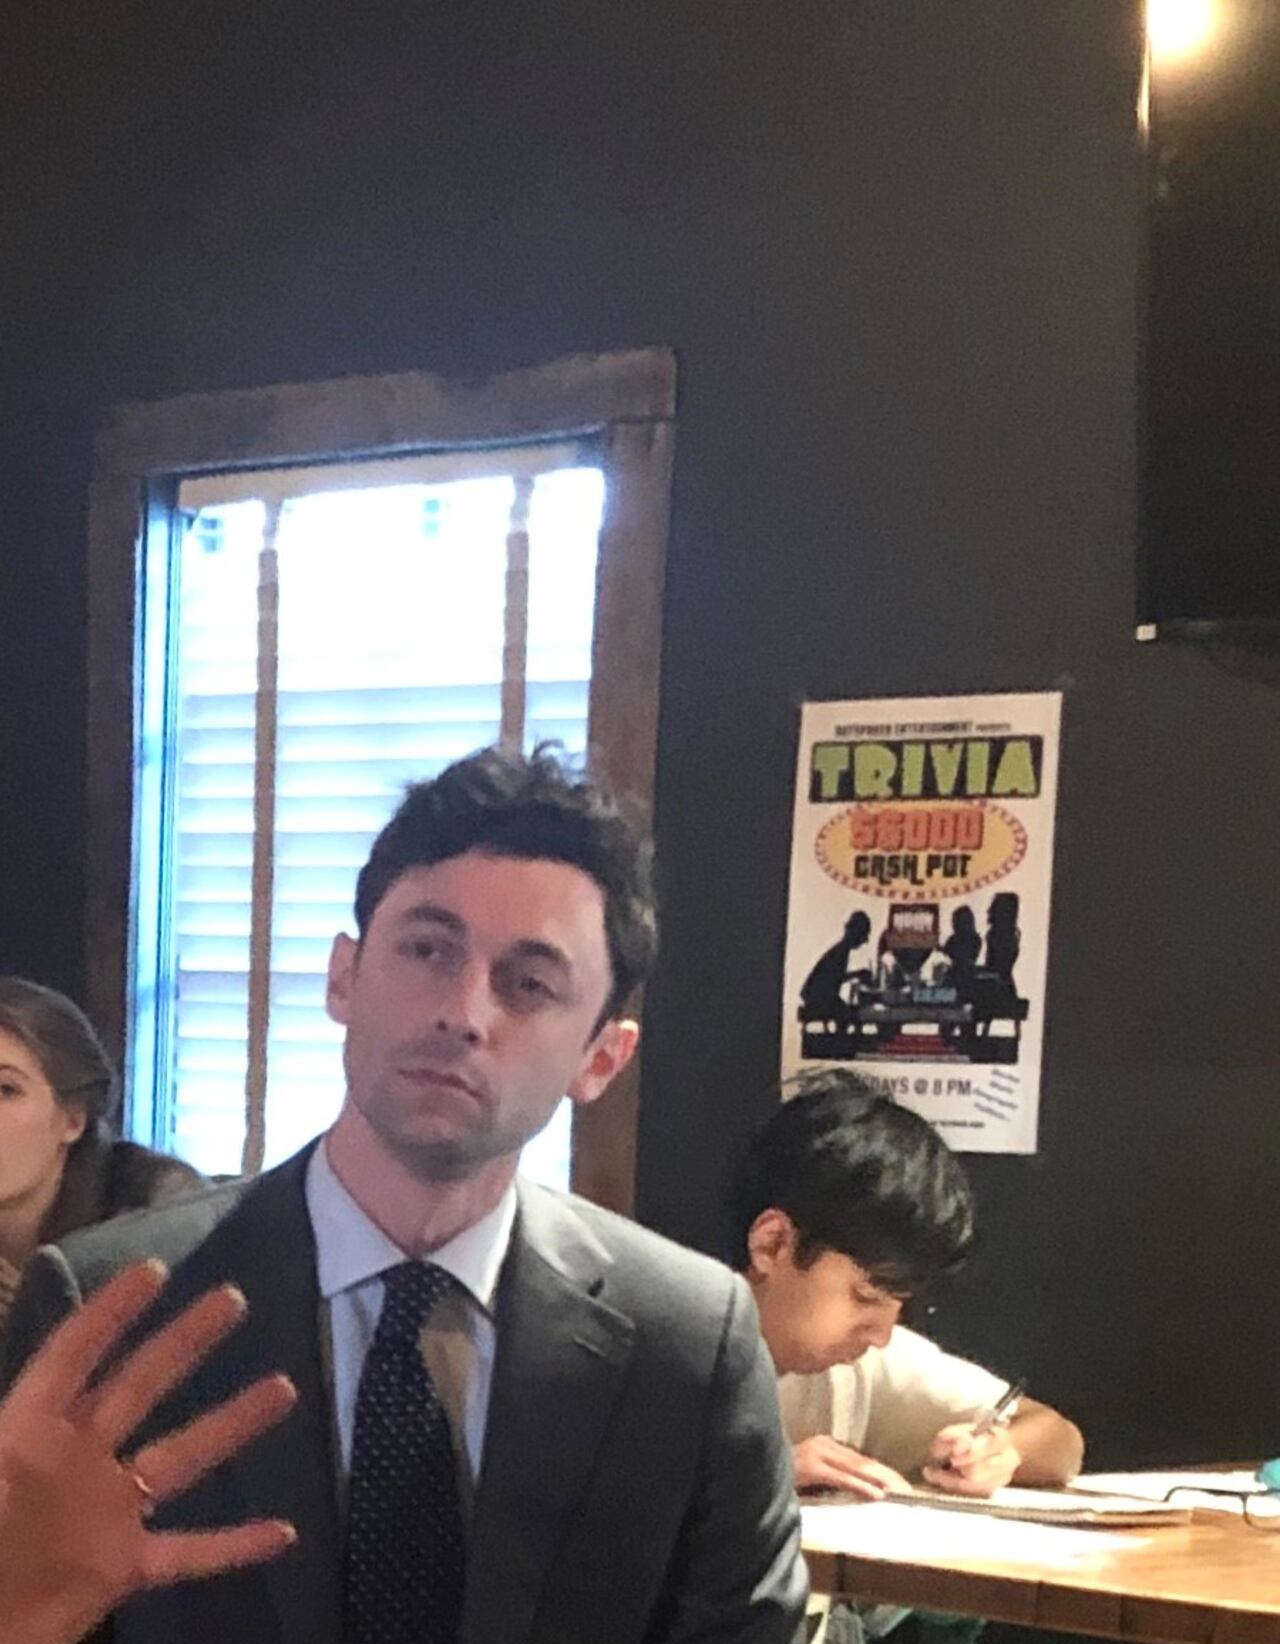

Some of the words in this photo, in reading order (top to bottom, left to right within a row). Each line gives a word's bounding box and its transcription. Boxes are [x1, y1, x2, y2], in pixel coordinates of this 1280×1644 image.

[813, 738, 1038, 798] TRIVIA
[853, 853, 925, 886] CASH
[925, 854, 972, 878] POT
[947, 1078, 972, 1096] PM
